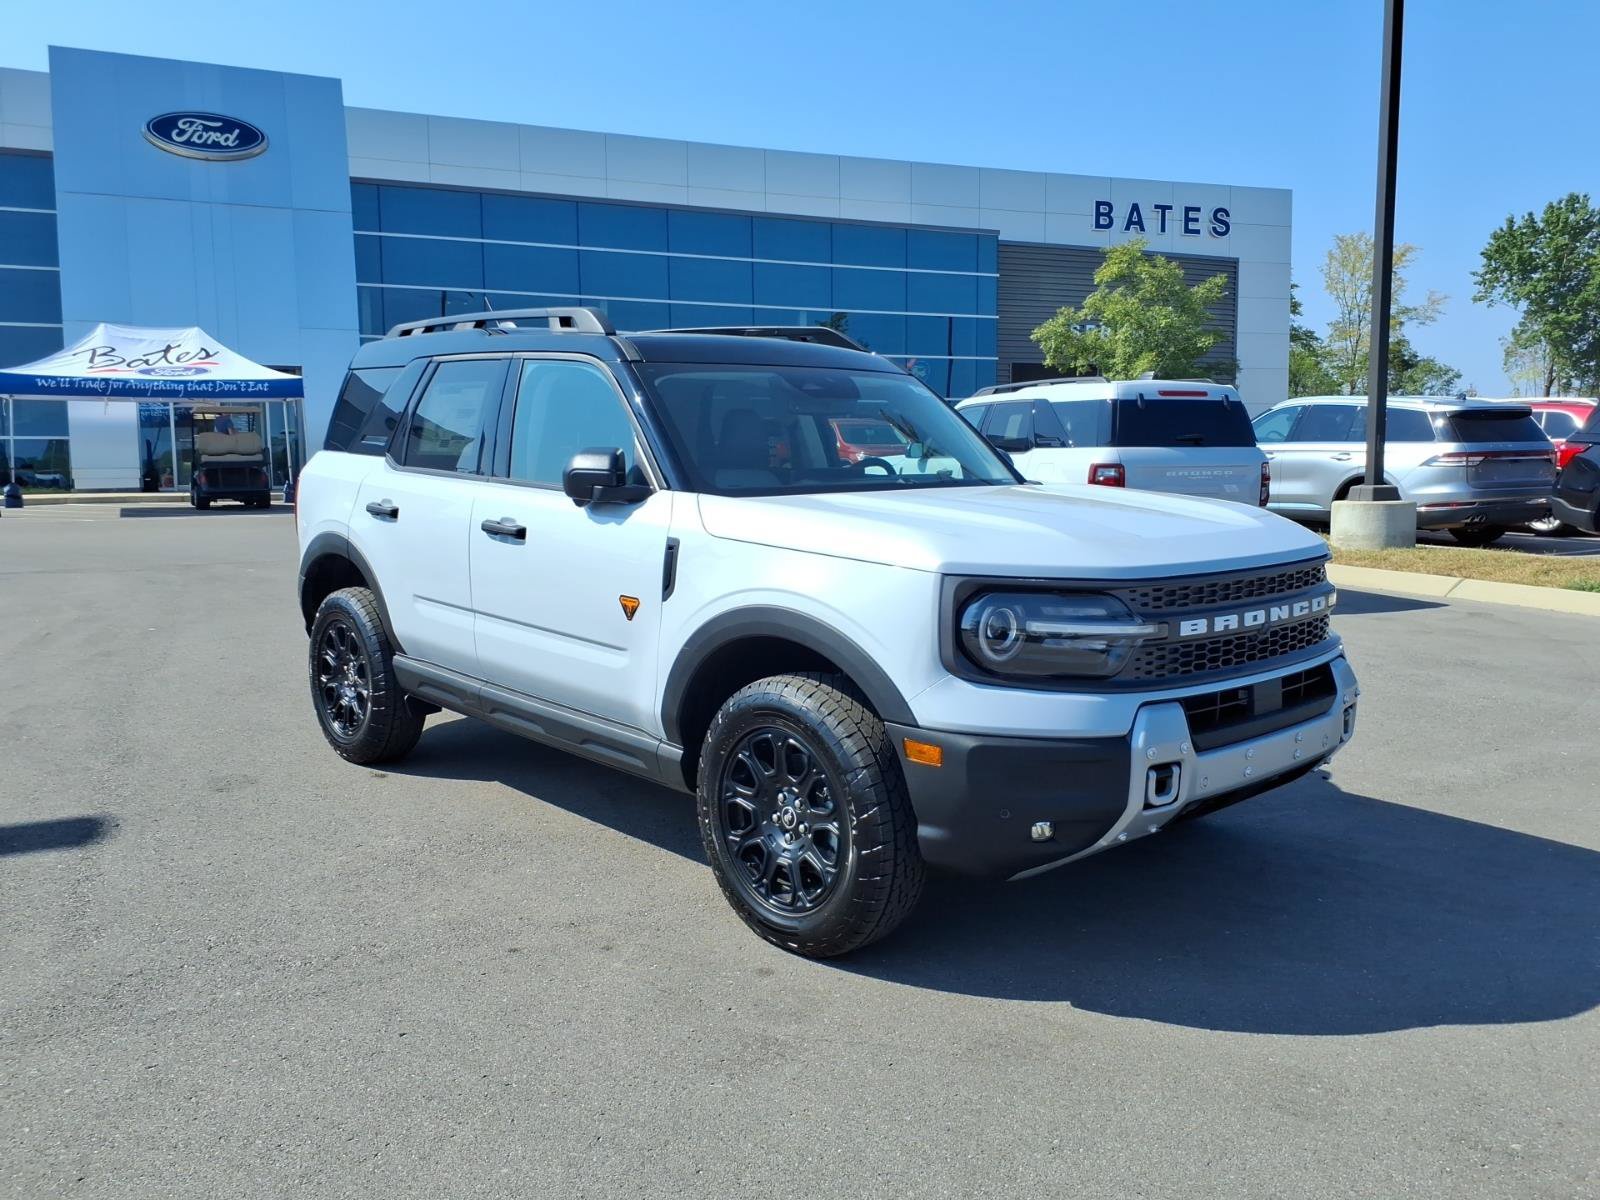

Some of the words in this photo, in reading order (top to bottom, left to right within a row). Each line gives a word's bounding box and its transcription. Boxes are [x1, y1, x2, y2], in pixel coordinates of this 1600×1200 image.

[171, 118, 240, 147] Ford
[1094, 200, 1231, 237] BATES
[72, 344, 220, 369] Bates
[151, 366, 197, 376] Ford
[35, 377, 70, 388] We'll
[72, 377, 106, 393] Trade
[106, 379, 124, 395] for
[125, 379, 184, 397] Anything
[187, 380, 214, 392] that
[215, 380, 246, 392] Don't
[247, 381, 269, 392] Eat
[1179, 597, 1326, 636] BRONCO
